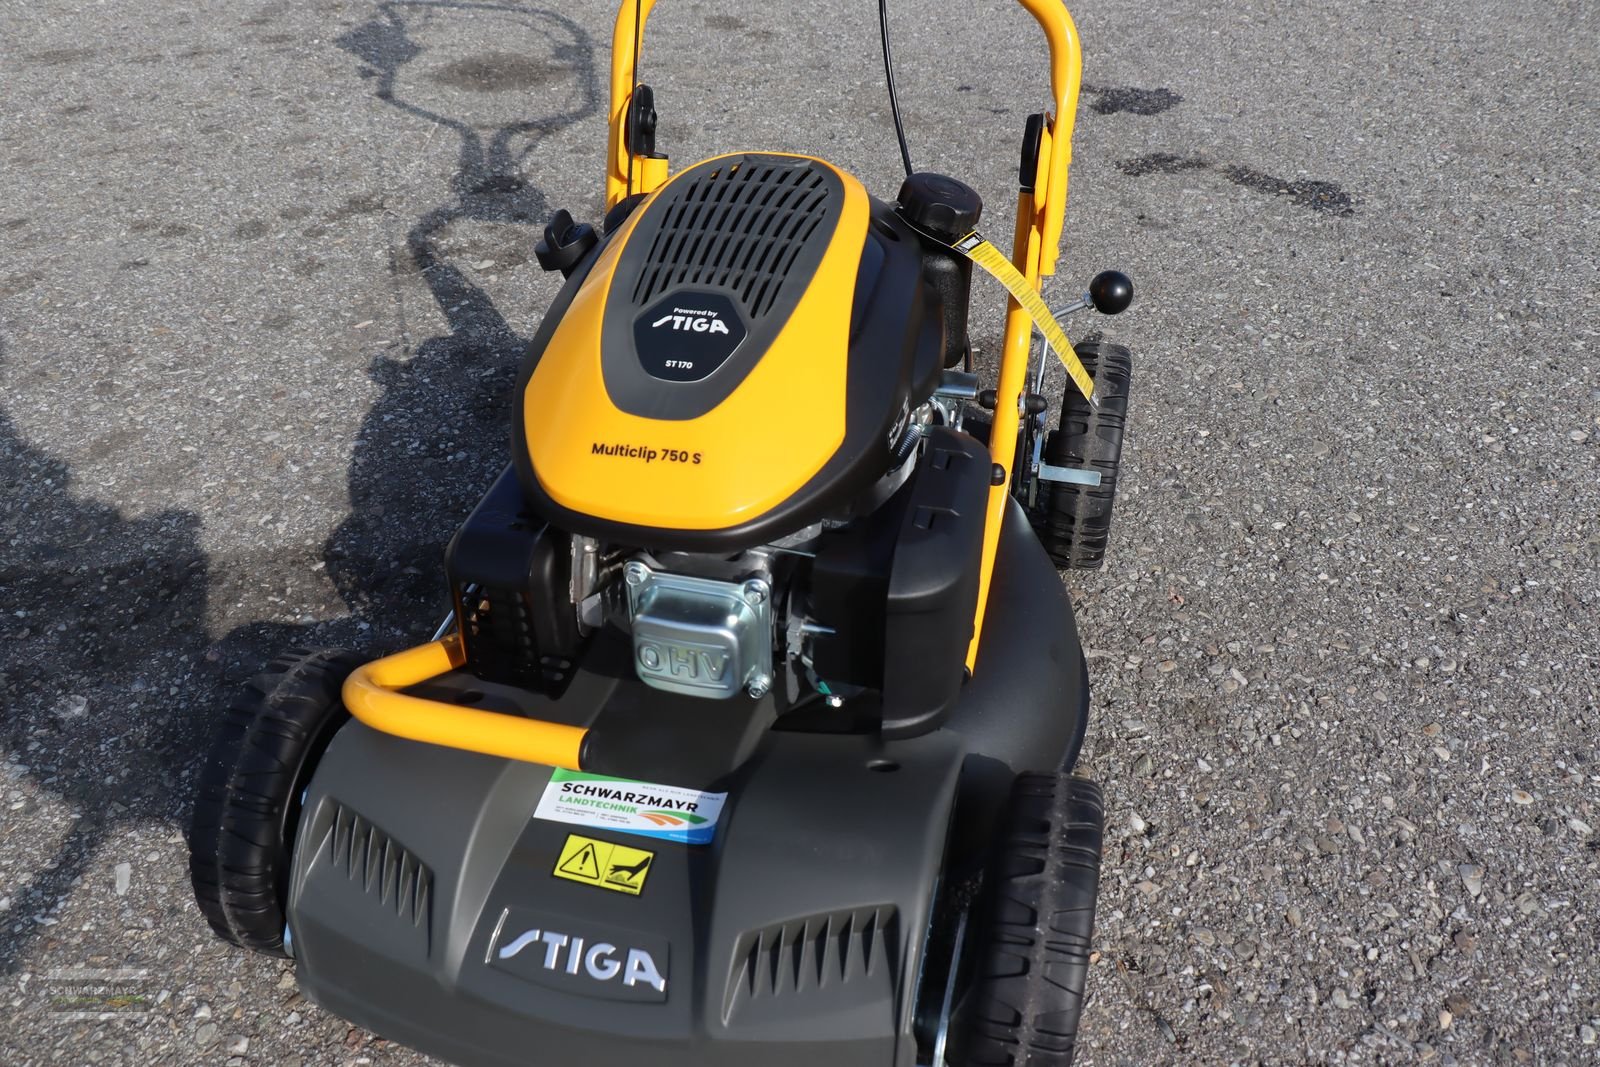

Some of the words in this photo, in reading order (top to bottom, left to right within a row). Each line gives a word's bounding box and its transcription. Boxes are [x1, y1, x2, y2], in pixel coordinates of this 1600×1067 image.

[673, 307, 707, 316] Powered
[707, 309, 718, 318] by
[652, 315, 730, 335] STIGA
[665, 359, 677, 368] ST
[678, 361, 693, 369] 170
[591, 442, 657, 463] Multiclip
[661, 448, 689, 463] 750
[692, 452, 702, 465] S
[638, 642, 730, 682] OHV
[559, 795, 638, 815] LANDTECHNIK
[561, 782, 699, 813] SCHWARZMAYR
[498, 929, 666, 993] STIGA
